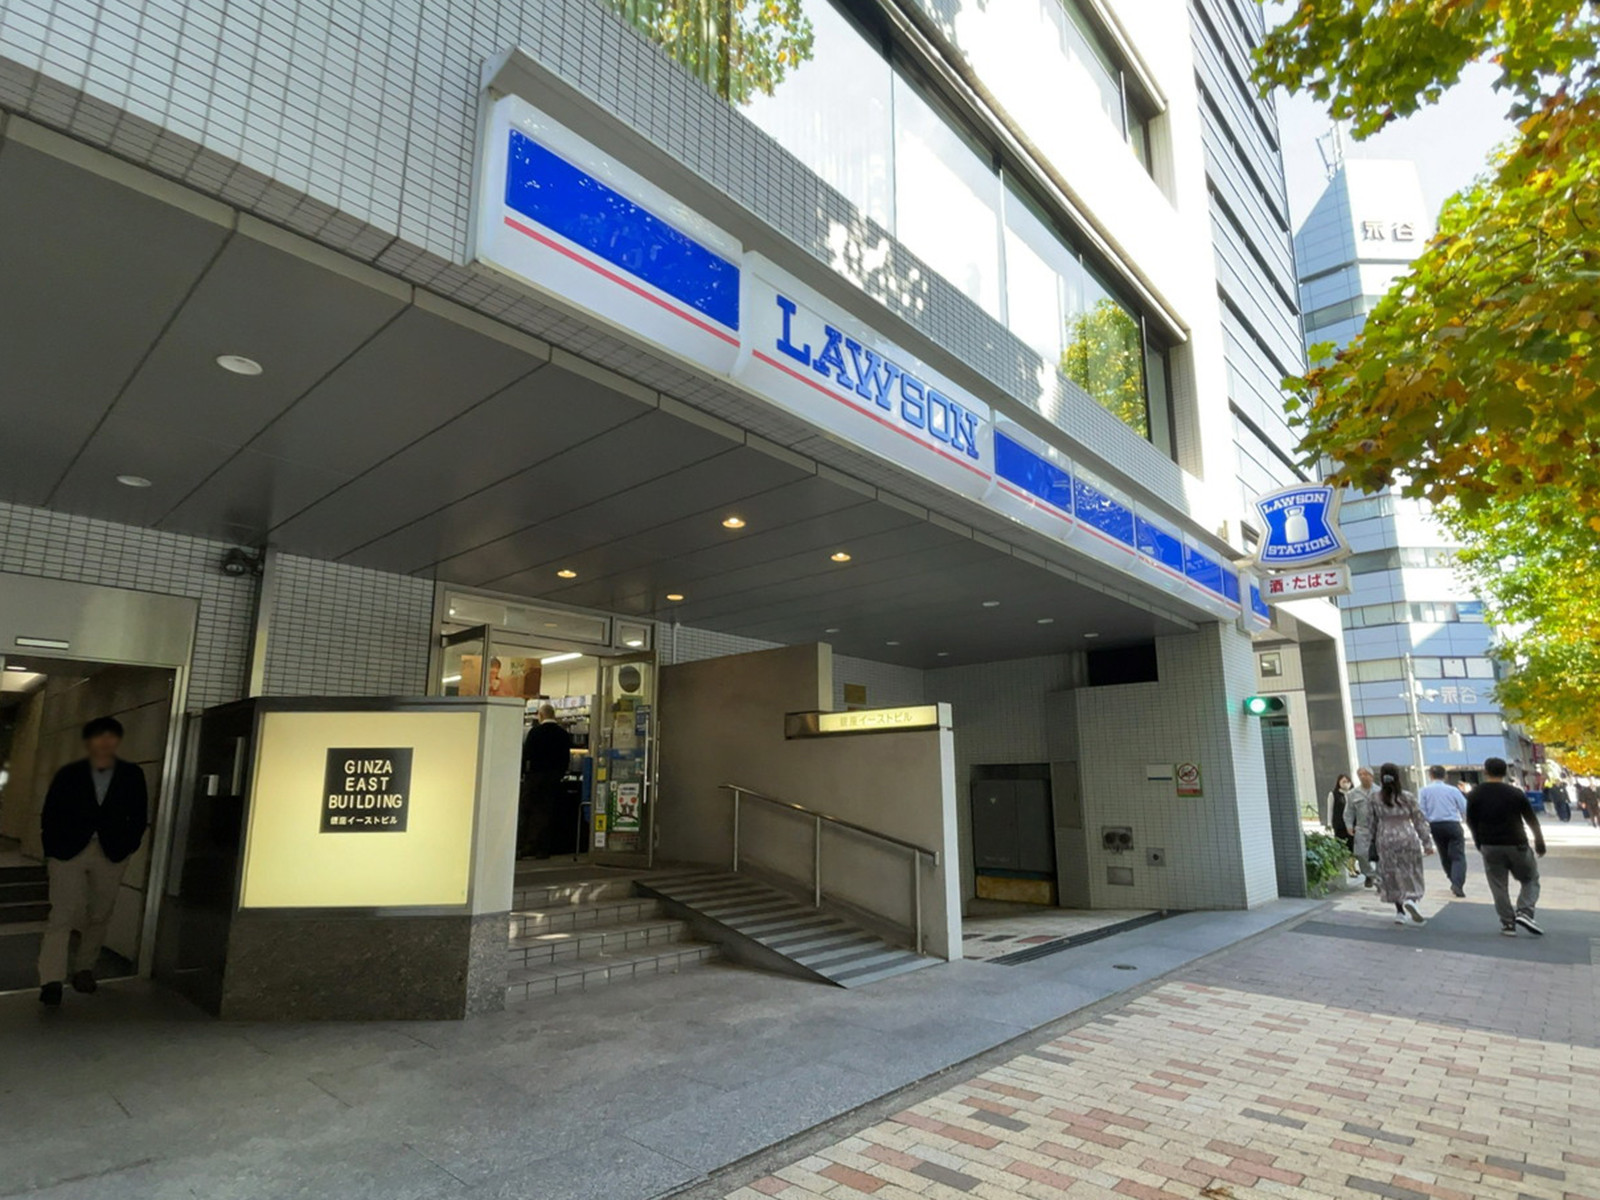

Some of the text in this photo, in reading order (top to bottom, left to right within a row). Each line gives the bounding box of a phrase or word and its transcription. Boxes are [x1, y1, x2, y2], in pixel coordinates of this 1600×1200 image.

[776, 293, 980, 461] LAWSON
[1263, 493, 1326, 514] LAWSON
[1267, 535, 1333, 556] STATION
[344, 760, 393, 774] GINZA
[345, 777, 390, 791] EAST
[328, 794, 403, 809] BUILDING
